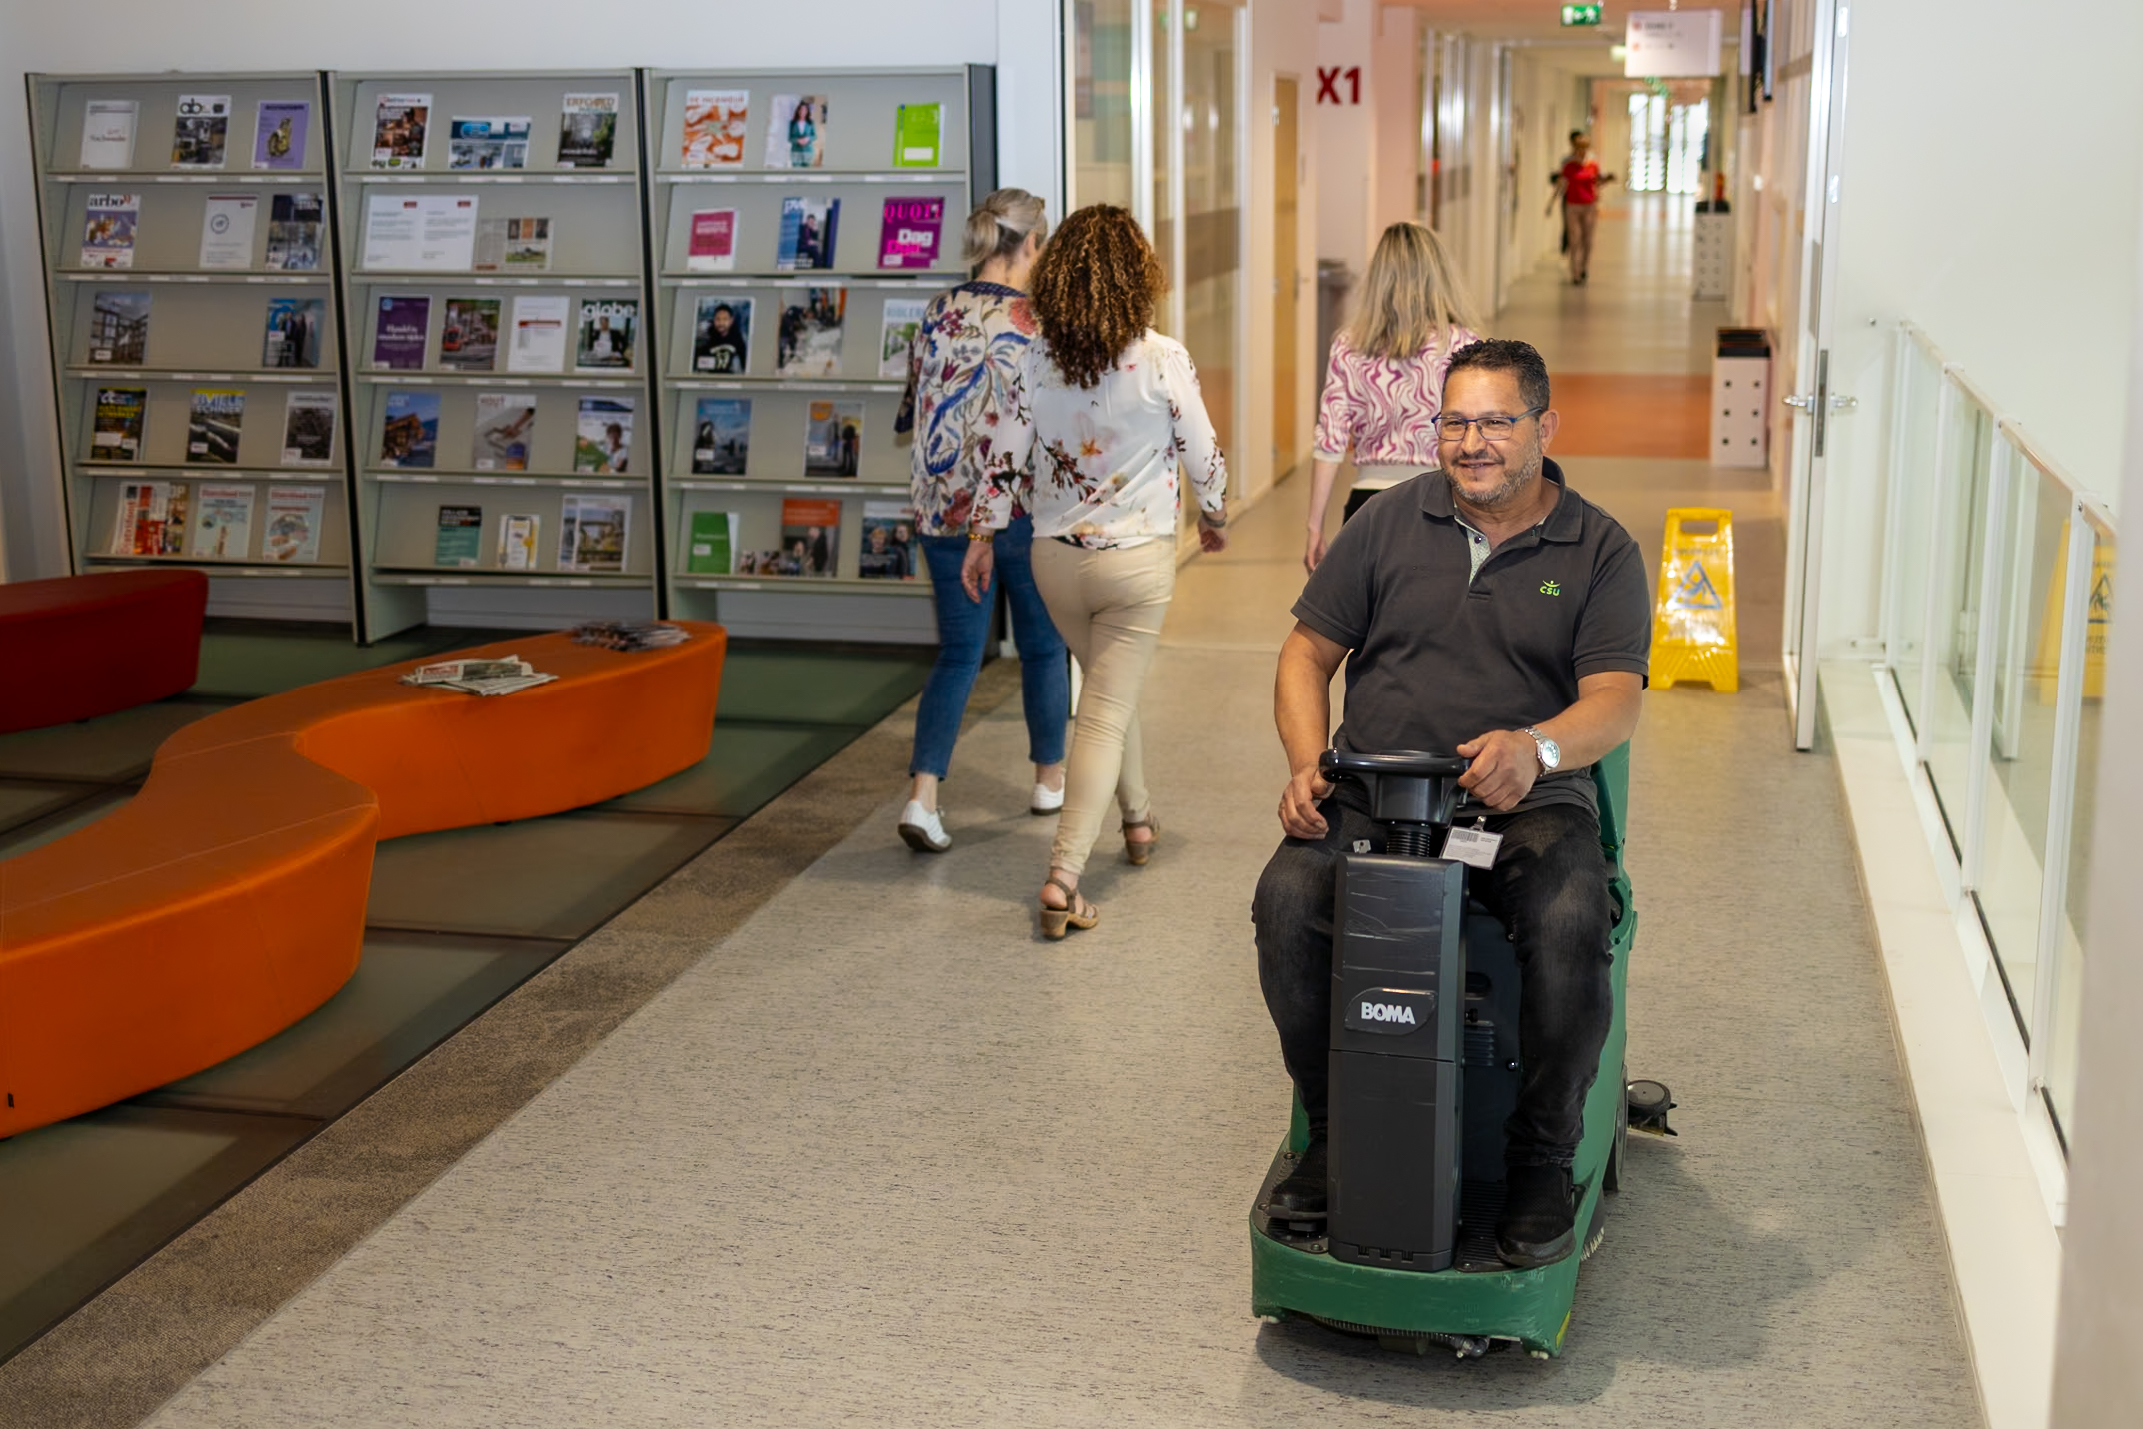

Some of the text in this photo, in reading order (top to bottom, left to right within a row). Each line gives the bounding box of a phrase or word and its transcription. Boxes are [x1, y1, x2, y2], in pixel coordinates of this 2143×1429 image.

[1317, 66, 1361, 104] X1
[90, 194, 124, 207] arbo
[899, 229, 934, 248] Dag
[583, 301, 638, 319] globe
[1540, 586, 1560, 596] CSU
[1361, 1001, 1416, 1025] BOMA
